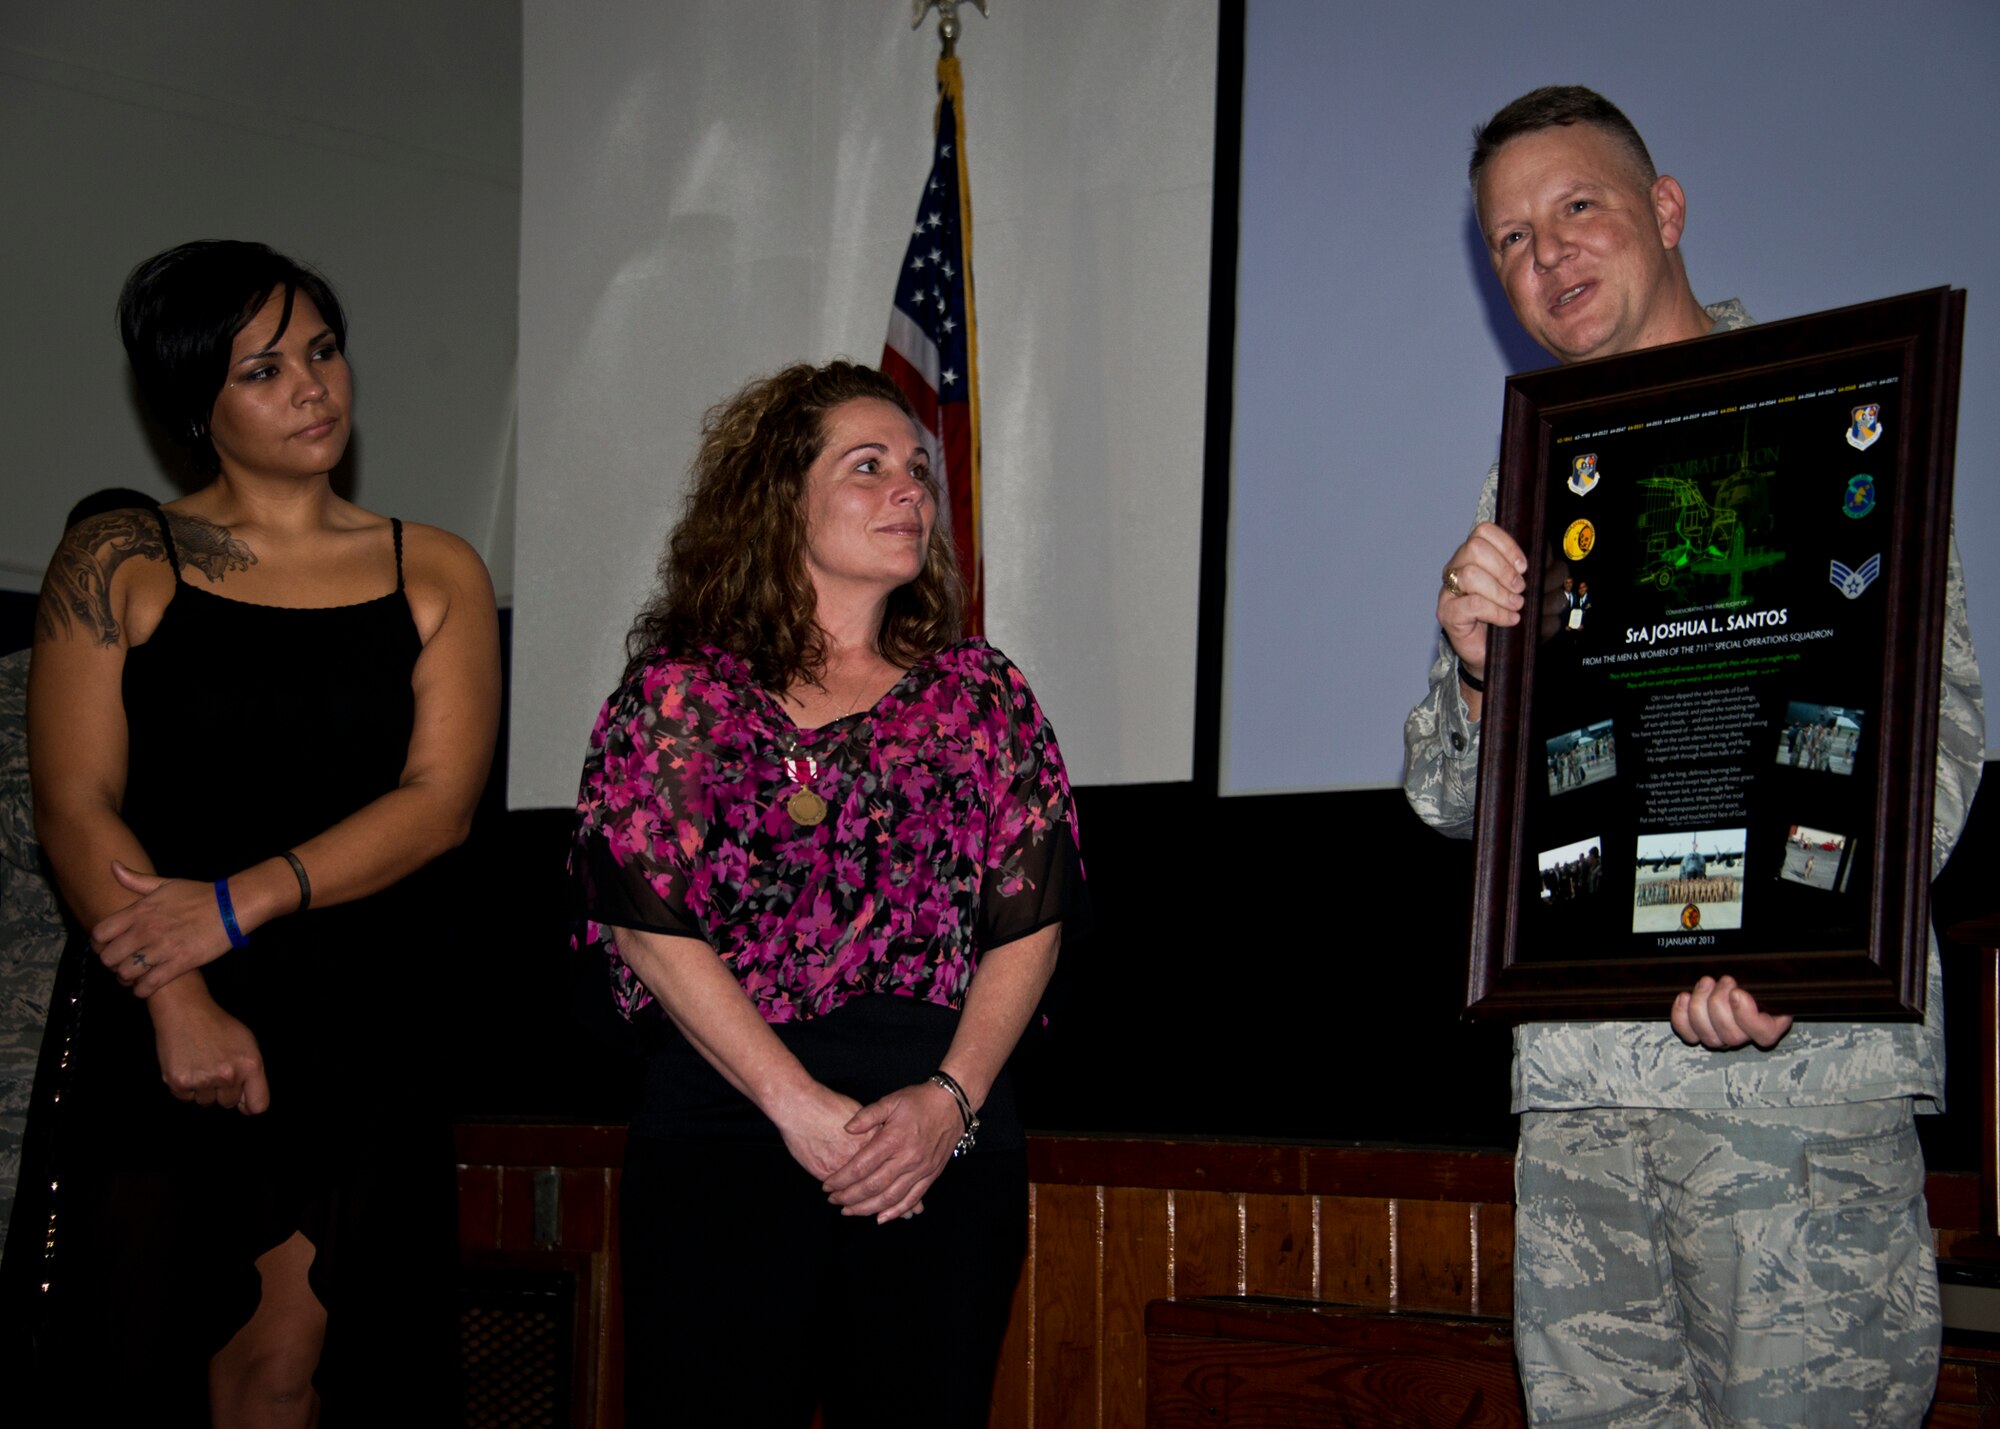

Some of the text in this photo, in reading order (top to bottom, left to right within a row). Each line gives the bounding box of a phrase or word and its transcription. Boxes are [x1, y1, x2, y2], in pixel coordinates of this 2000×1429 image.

[1625, 608, 1788, 645] SrA JOSHUA L. SANTOS
[1582, 656, 1602, 666] FROM
[1603, 654, 1616, 664] THE
[1616, 653, 1633, 662] MEN
[1633, 652, 1639, 661] &
[1640, 648, 1669, 659] WOMEN
[1669, 646, 1679, 656] OF
[1681, 645, 1695, 654] THE
[1715, 640, 1742, 651] SPECIAL
[1742, 633, 1789, 648] OPERATIONS
[1789, 629, 1834, 643] SQUADRON
[1657, 935, 1715, 948] 13 JANUARY 2013
